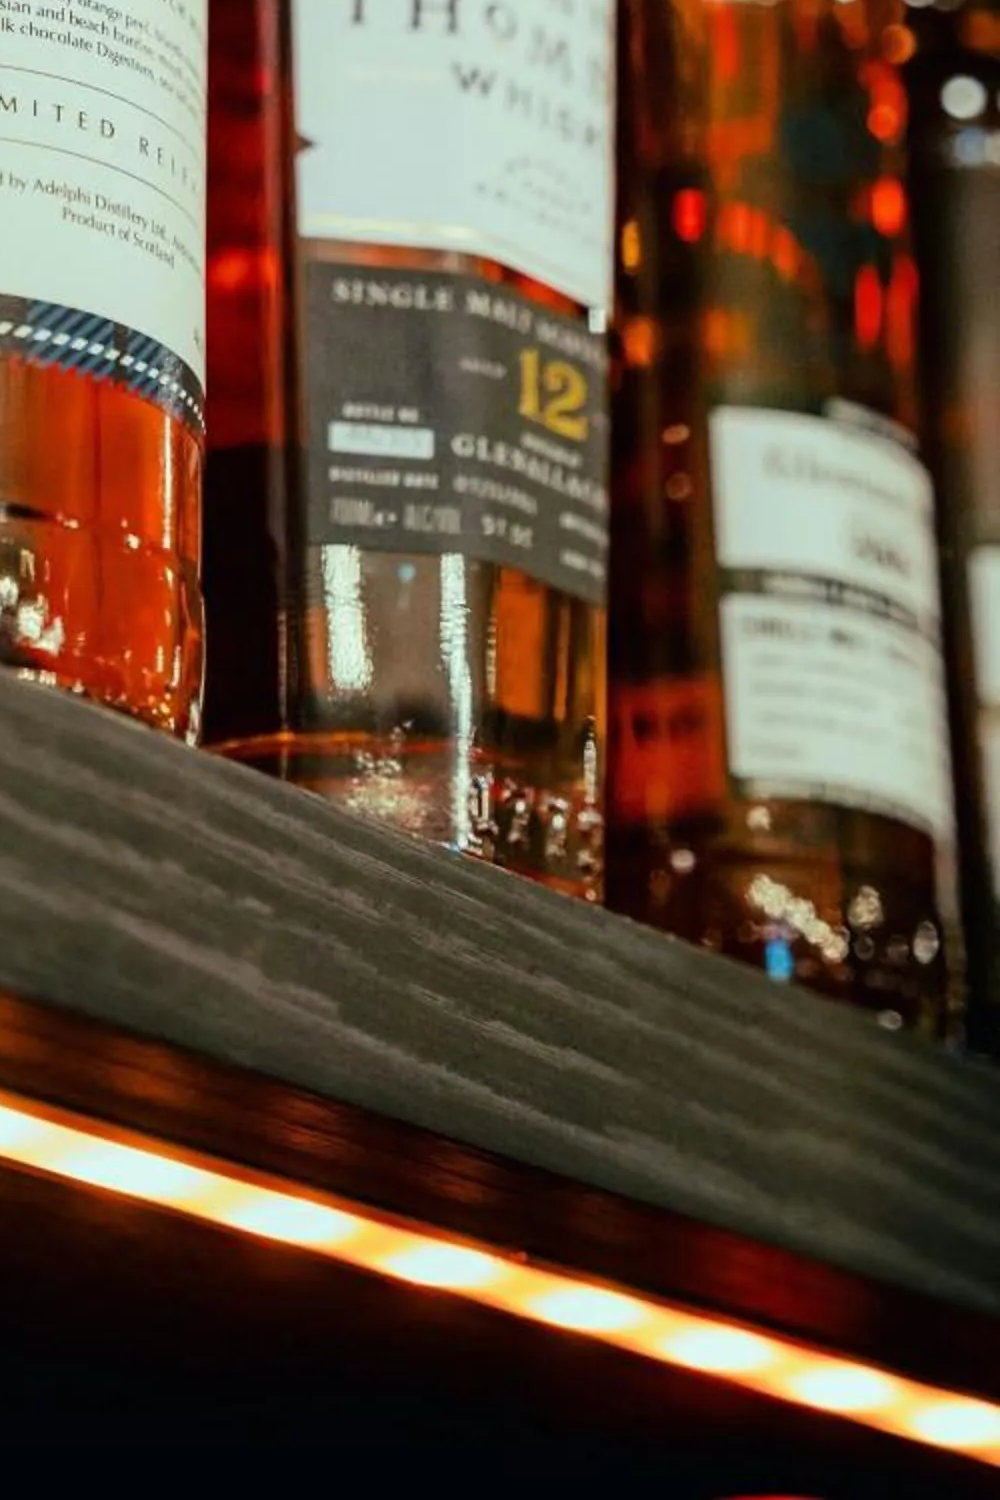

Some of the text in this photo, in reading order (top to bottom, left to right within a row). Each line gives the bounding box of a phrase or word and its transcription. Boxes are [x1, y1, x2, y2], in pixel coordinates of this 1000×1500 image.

[20, 22, 93, 51] chocolate
[36, 8, 65, 22] and
[69, 10, 109, 35] beach
[9, 170, 28, 194] by
[34, 179, 91, 208] Adelphi
[95, 193, 149, 232] Distillery
[62, 206, 115, 237] Product
[118, 226, 132, 243] of
[134, 232, 175, 268] Scotland
[332, 278, 454, 311] SINGLE
[518, 348, 590, 442] 12
